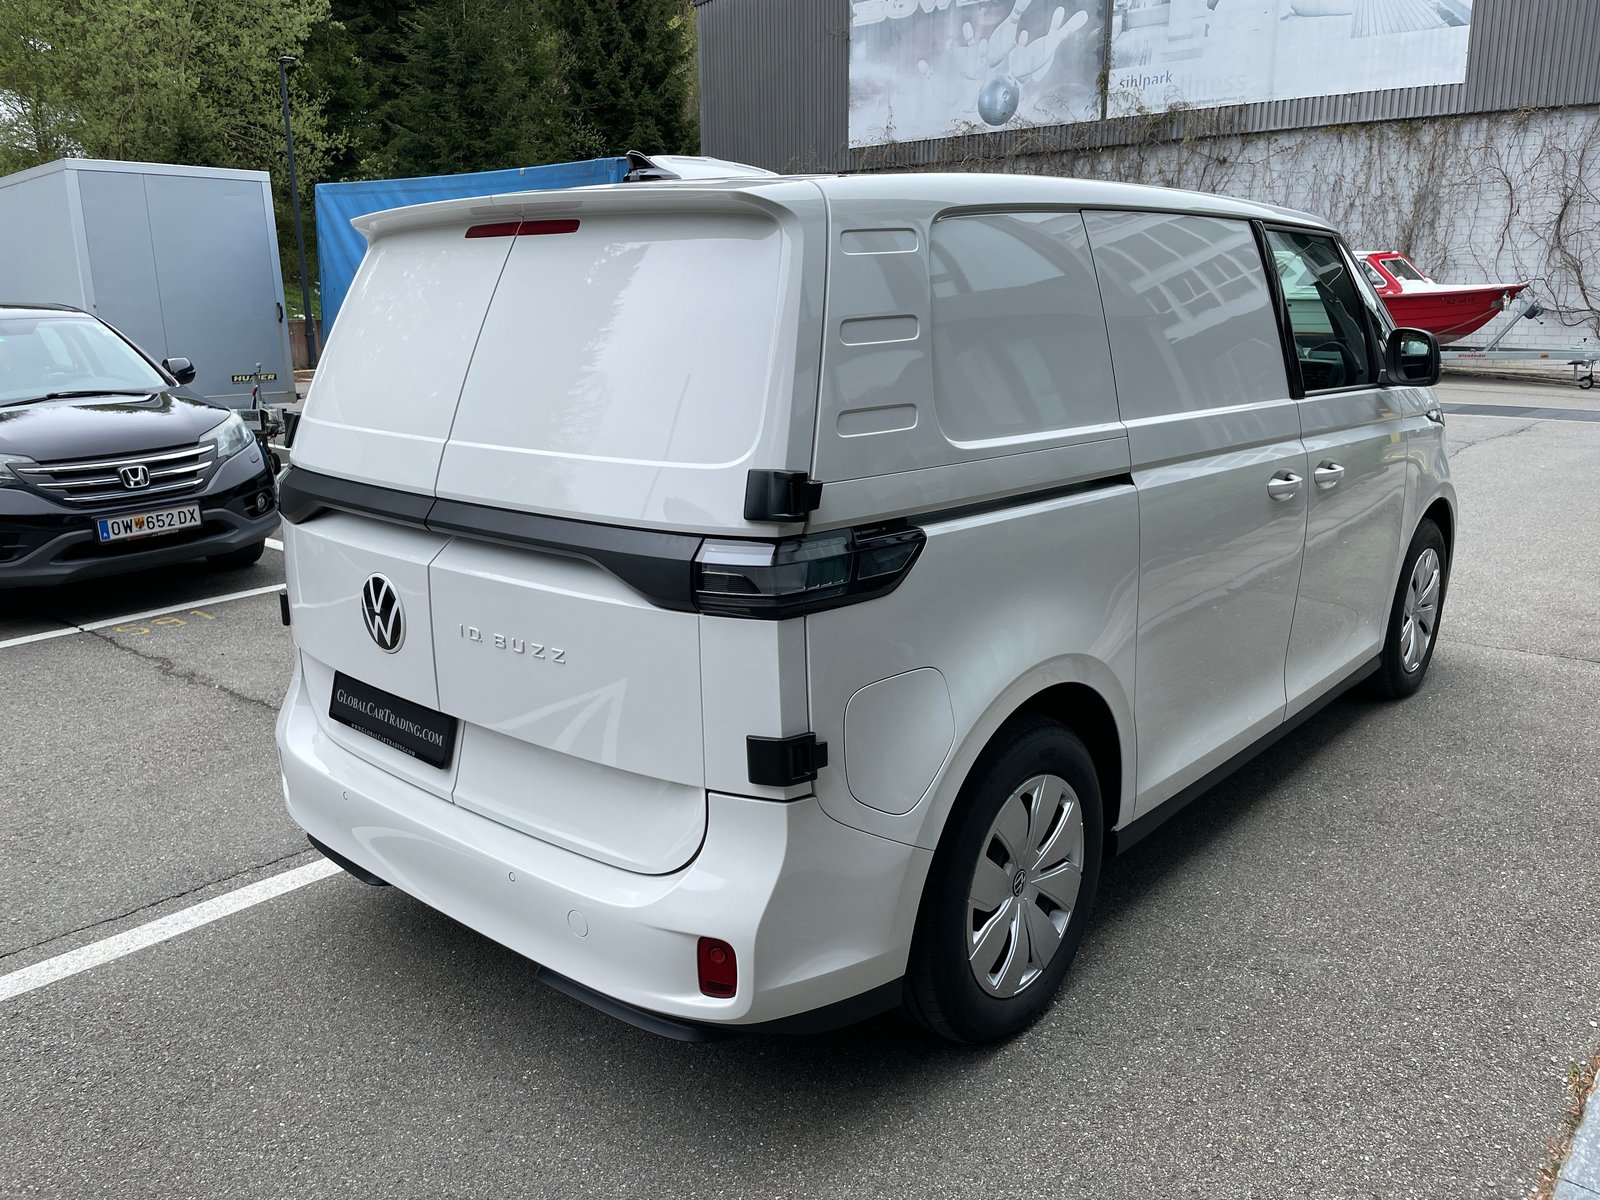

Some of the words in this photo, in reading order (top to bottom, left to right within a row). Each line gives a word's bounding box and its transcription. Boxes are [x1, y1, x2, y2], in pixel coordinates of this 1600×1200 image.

[1119, 70, 1173, 91] sihlpark
[111, 518, 133, 536] OW
[146, 512, 175, 530] 652
[178, 508, 197, 525] DX
[494, 633, 566, 664] BUZZ
